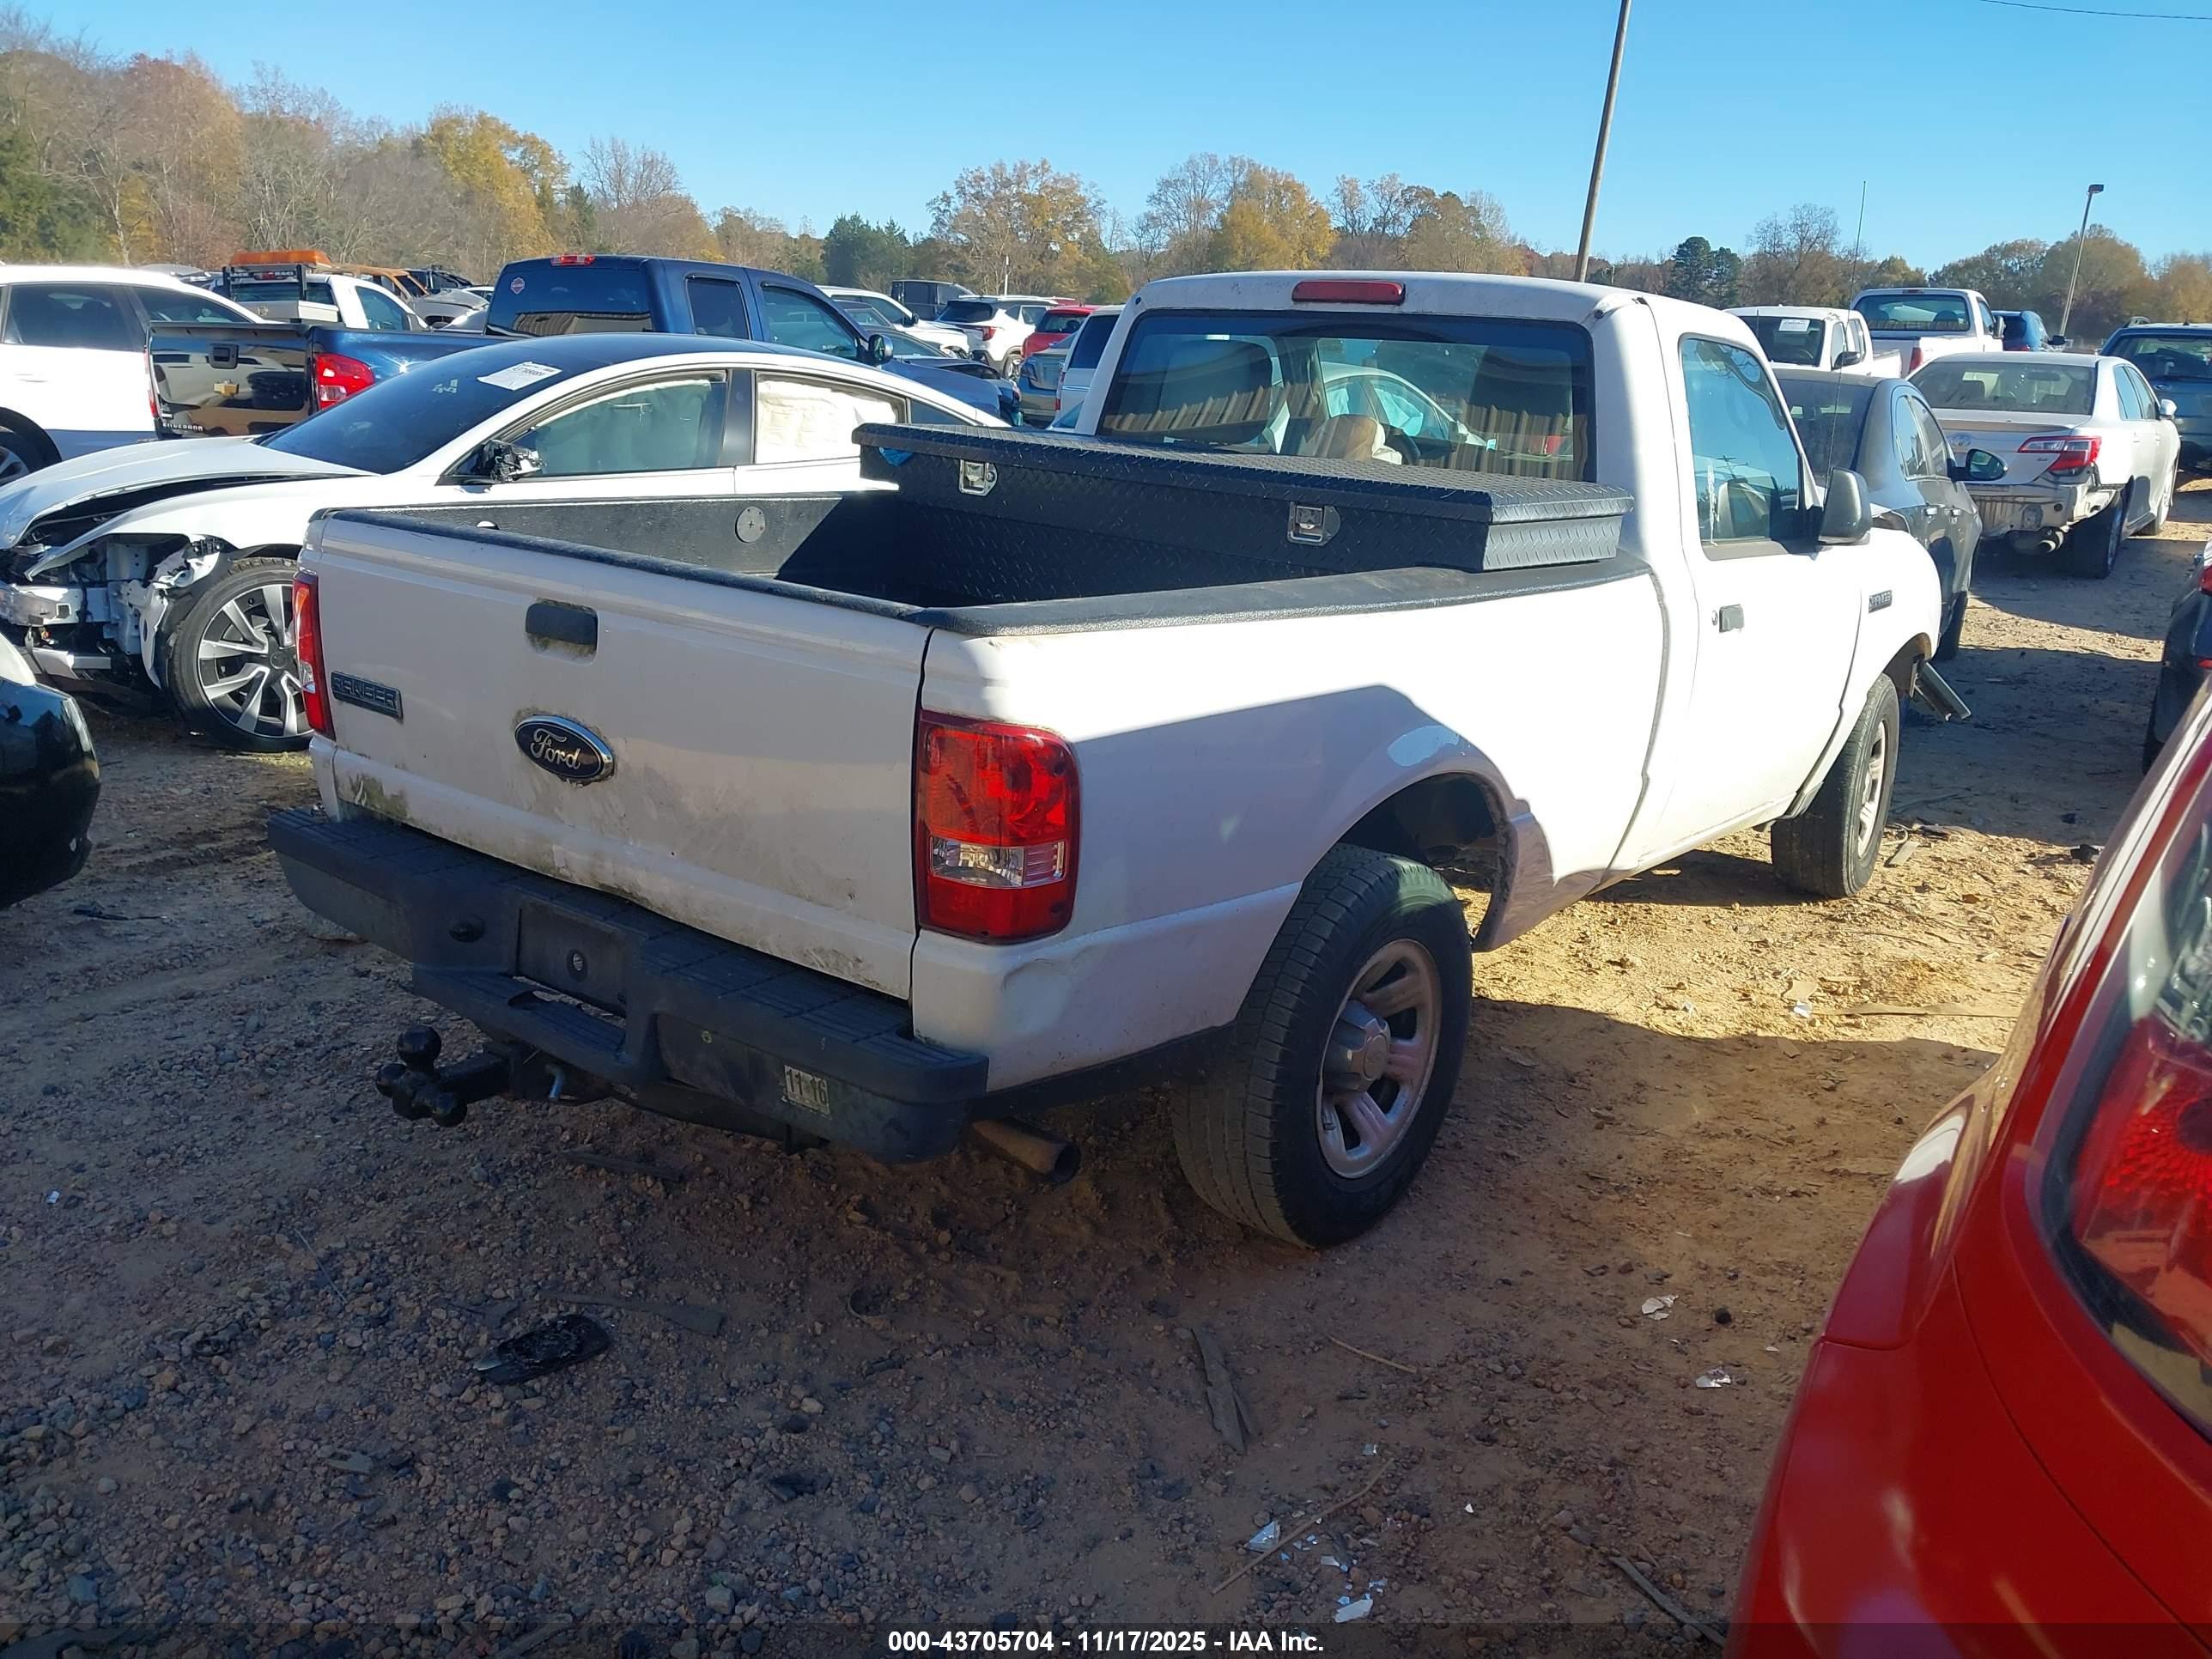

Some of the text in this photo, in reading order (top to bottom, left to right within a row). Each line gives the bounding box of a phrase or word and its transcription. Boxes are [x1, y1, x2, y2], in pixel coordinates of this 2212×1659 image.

[333, 677, 398, 709] RANGER
[530, 727, 582, 770] Ford
[786, 1068, 803, 1096] 11
